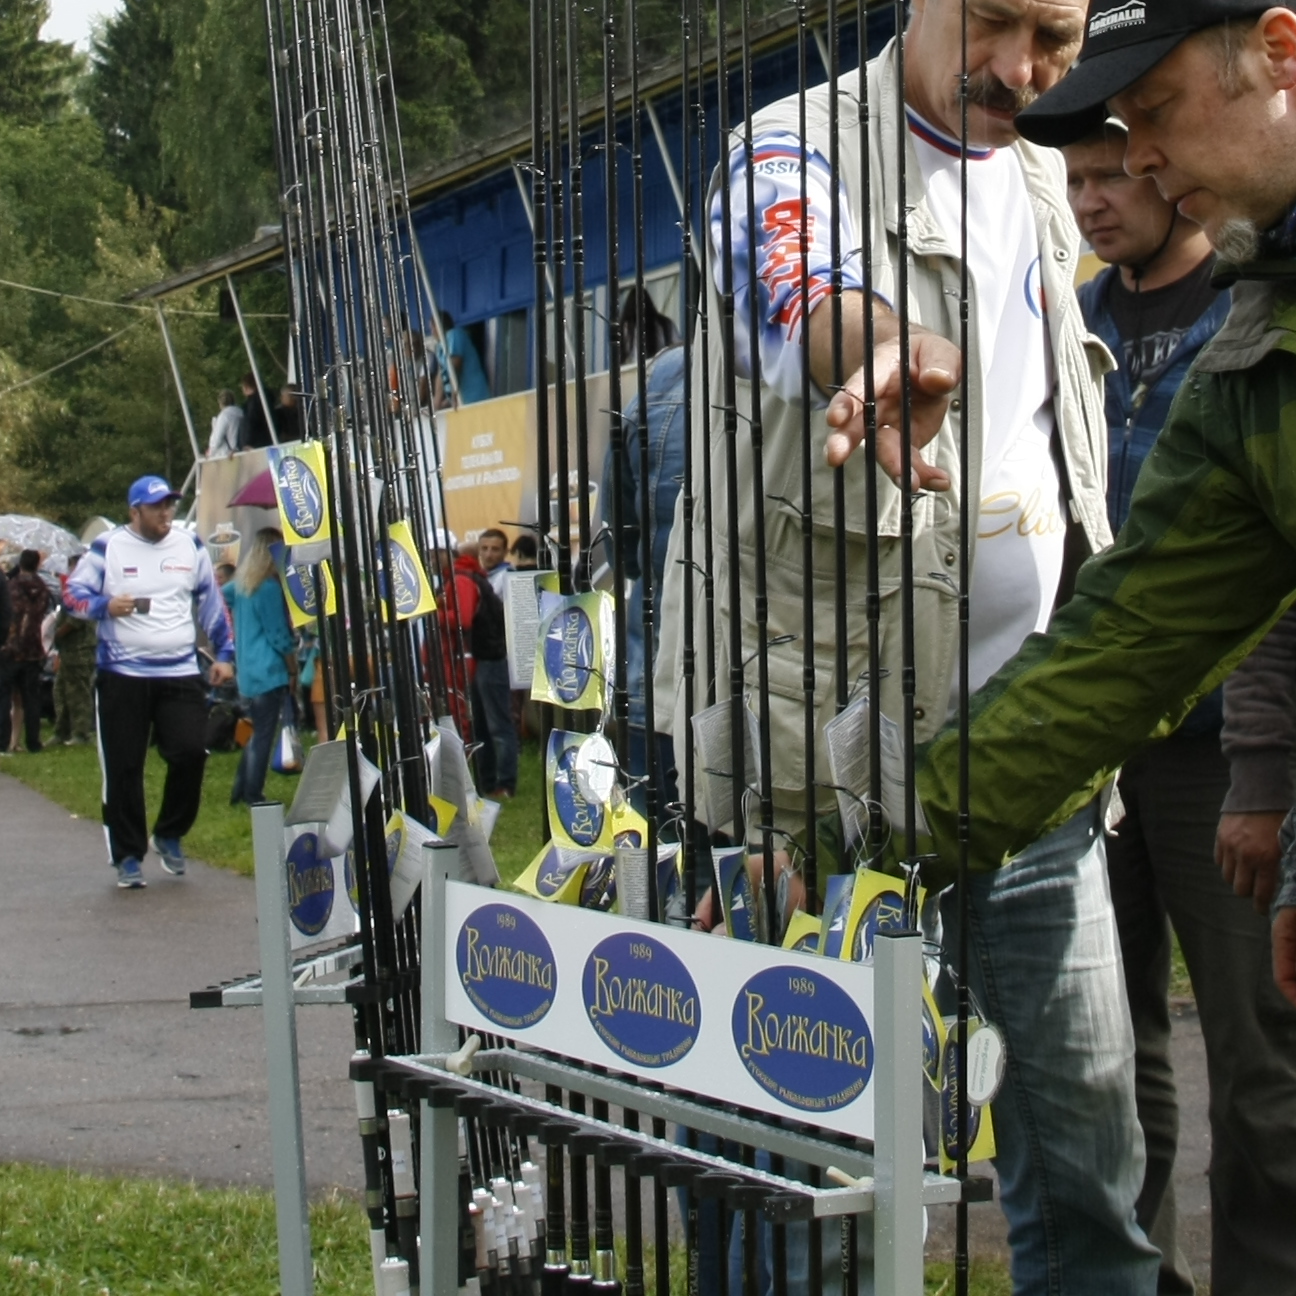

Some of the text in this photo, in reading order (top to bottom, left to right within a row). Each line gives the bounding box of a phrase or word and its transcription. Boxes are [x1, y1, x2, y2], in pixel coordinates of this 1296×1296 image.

[555, 611, 581, 694] Волжанка
[496, 912, 517, 930] 1989
[629, 943, 653, 962] 1989
[463, 925, 553, 991] Волжанка
[589, 954, 695, 1027] Волжанка
[788, 976, 815, 998] 1989
[741, 988, 867, 1069] Волжанка
